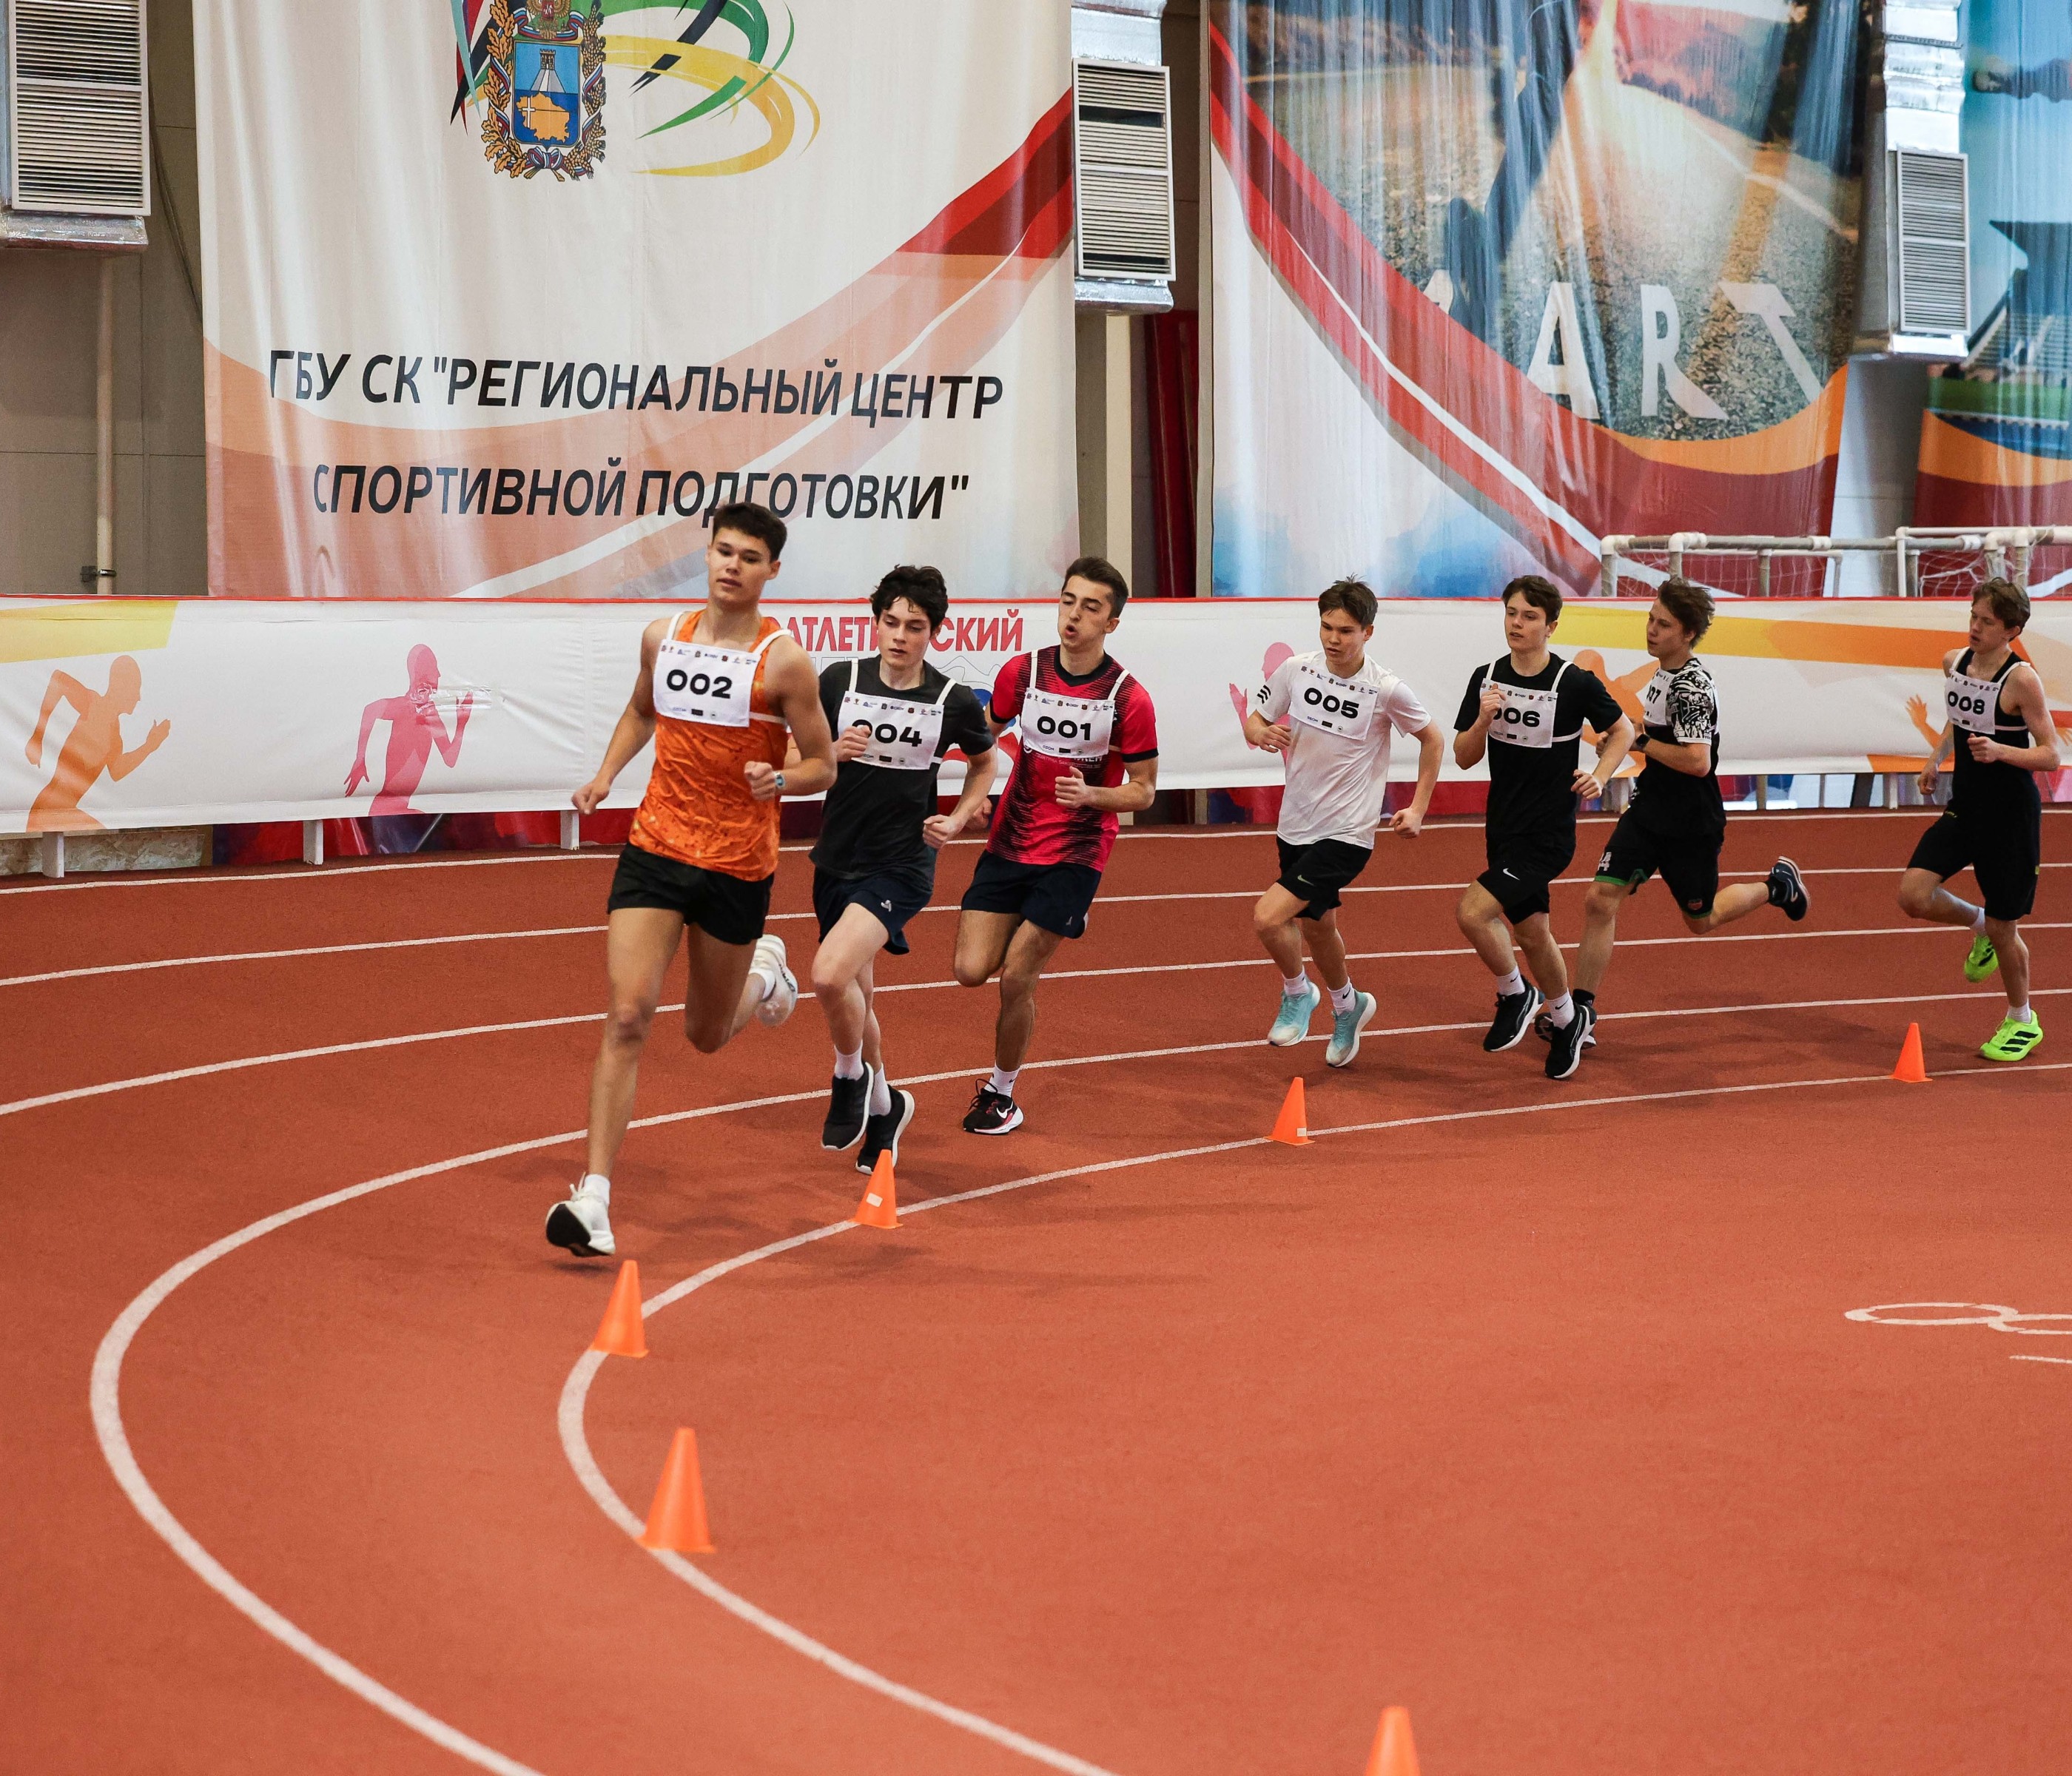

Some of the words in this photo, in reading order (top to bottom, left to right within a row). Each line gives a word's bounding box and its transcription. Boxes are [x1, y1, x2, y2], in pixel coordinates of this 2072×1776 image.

[1422, 269, 1825, 421] ART
[269, 349, 351, 400] ГБУ
[362, 354, 423, 403] СК
[434, 356, 842, 416] "РЕГИОНАЛЬНЫЙ
[850, 372, 1004, 428] ЦЕНТР
[313, 457, 628, 517] СПОРТИВНОЙ
[666, 669, 733, 699] 002
[1304, 687, 1360, 719] 005
[1947, 690, 1985, 716] 008
[1037, 716, 1092, 741] 001
